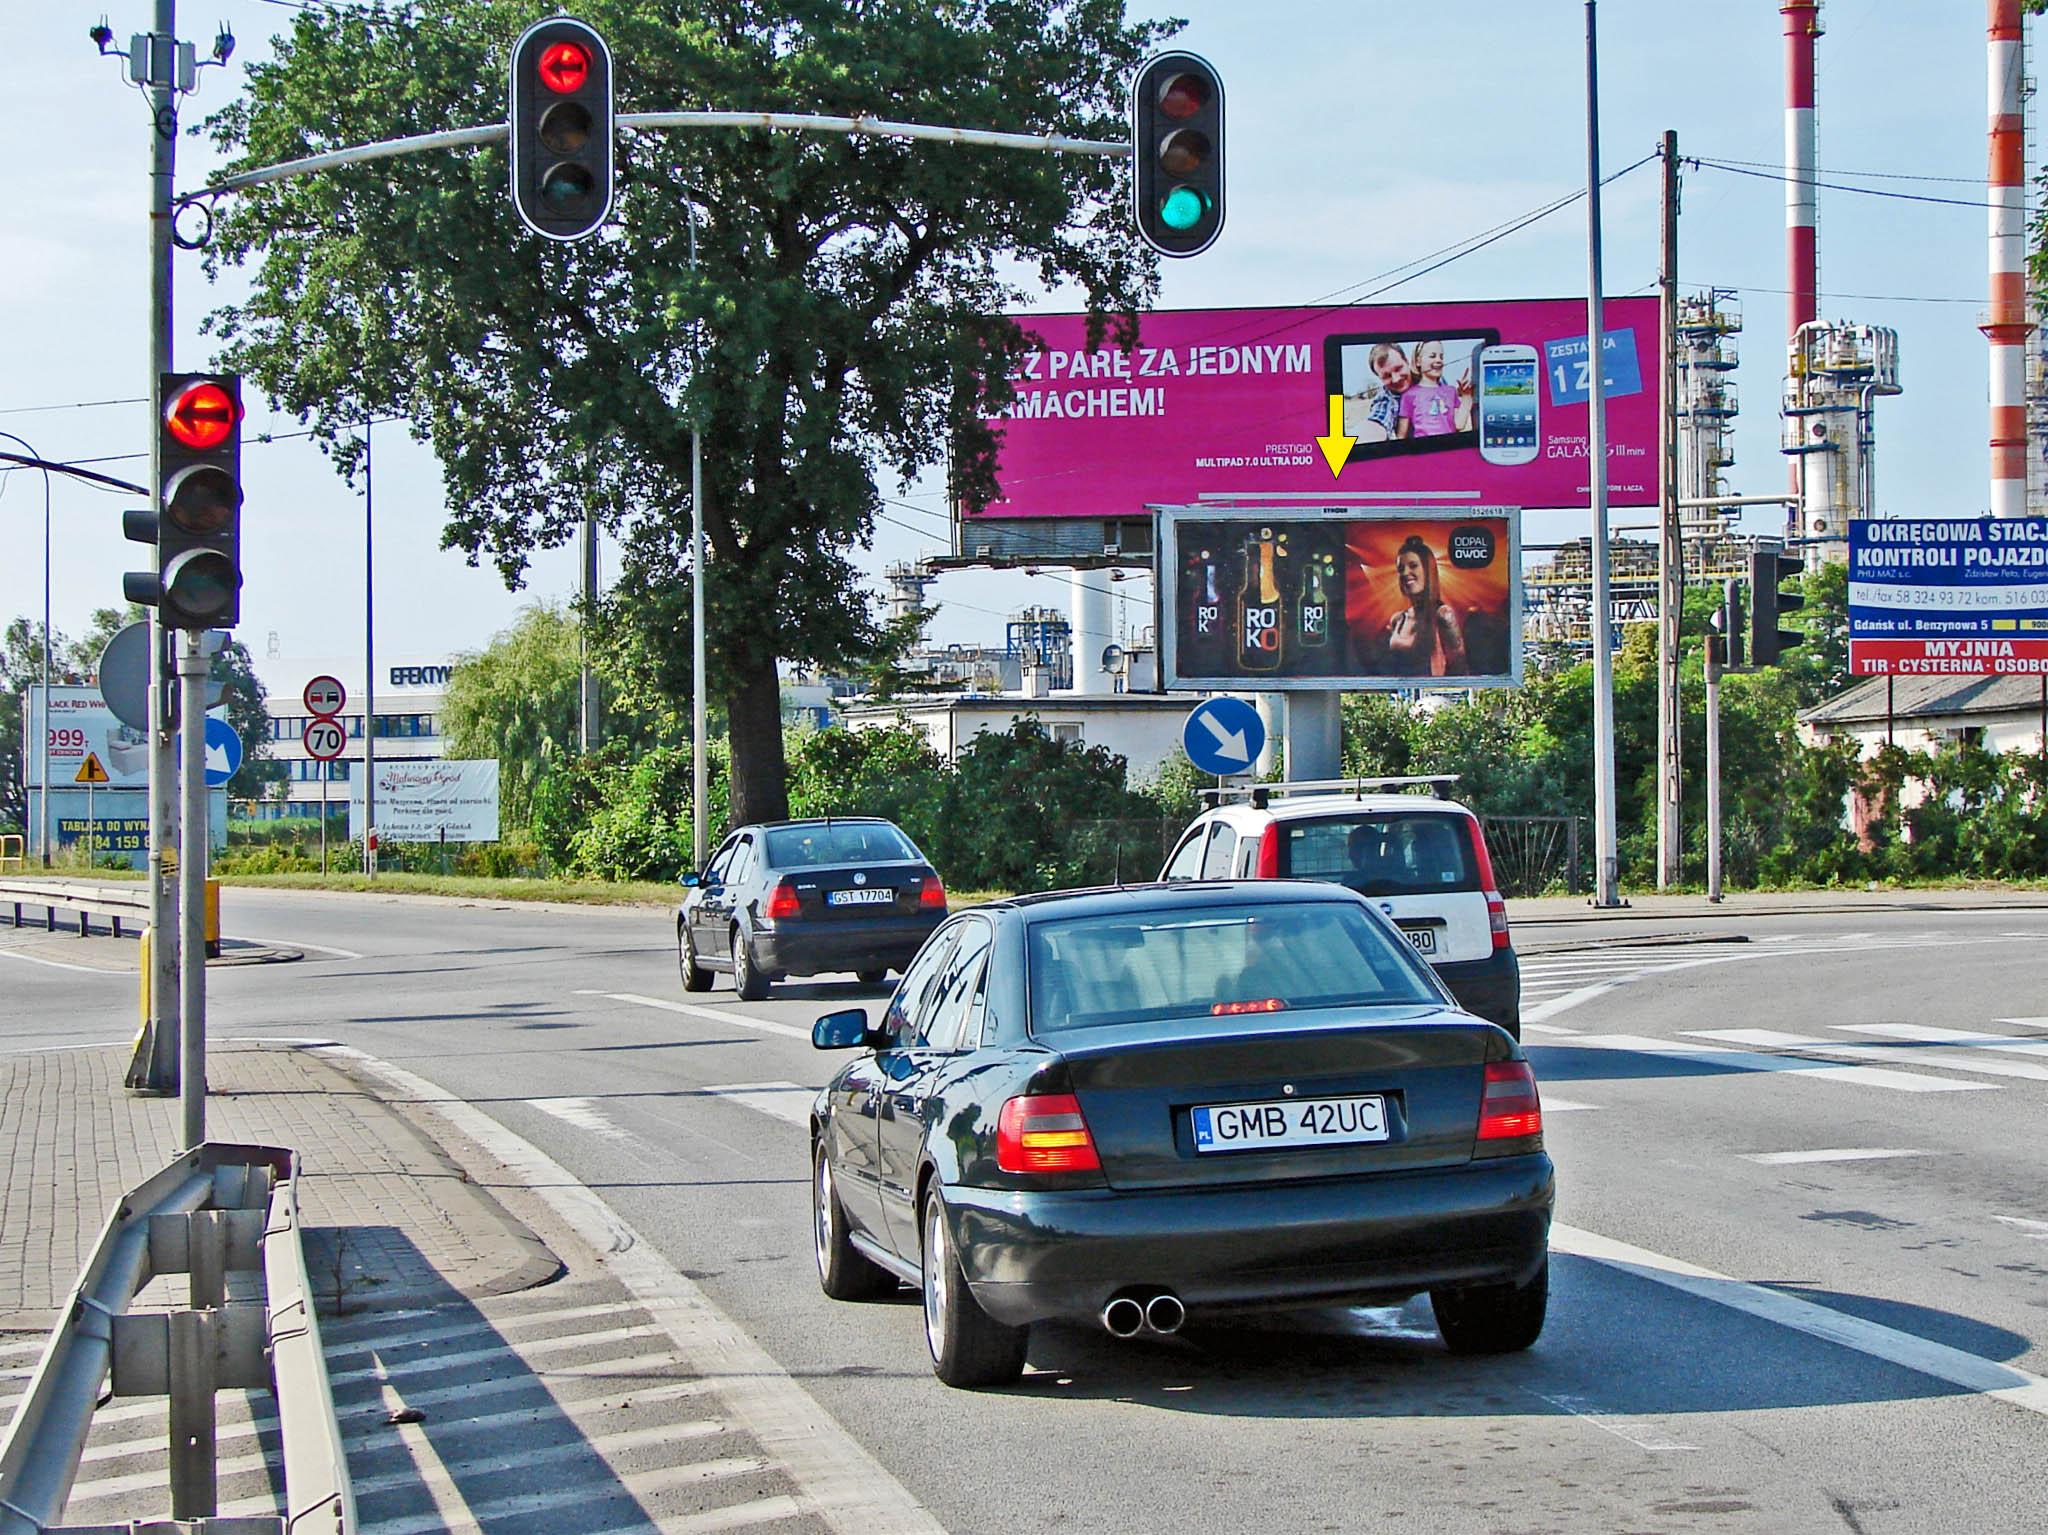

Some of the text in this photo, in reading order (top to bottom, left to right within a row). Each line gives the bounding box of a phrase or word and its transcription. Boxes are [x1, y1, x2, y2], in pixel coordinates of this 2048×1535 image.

[1550, 341, 1589, 358] ZESTA
[1050, 350, 1132, 383] PARĘ
[1139, 348, 1180, 377] ZA
[1185, 344, 1312, 376] JEDNYM
[1554, 364, 1567, 393] 1
[976, 387, 1166, 420] MACHEM!
[1548, 435, 1587, 445] Samsung
[1265, 443, 1313, 454] PRESTIGIO
[1547, 445, 1590, 459] GALAX
[1627, 447, 1645, 456] mini
[1195, 456, 1313, 468] MULTIPAD 7.0 ULTRA DUO
[1867, 522, 1982, 546] OKRĘGOWA
[1455, 536, 1488, 547] ODPAL
[1455, 549, 1488, 559] OWOC
[1857, 547, 2048, 567] KONTROLI POJAZD
[1896, 589, 1910, 603] 58
[1914, 590, 1935, 604] 324
[1939, 591, 1953, 605] 93
[1958, 591, 1972, 605] 72
[2005, 591, 2028, 605] 516
[1198, 607, 1218, 620] RO
[1246, 608, 1276, 628] RO
[1304, 606, 1323, 620] RO
[1854, 619, 1895, 631] Gdańsk
[1897, 619, 1912, 631] ul.
[1915, 619, 1978, 632] Benzynowa
[1981, 619, 1988, 630] 5
[1246, 628, 1279, 651] KO
[1924, 641, 2014, 657] MYJNIA
[1861, 658, 2048, 673] TIR CYSTERNA OSOBO
[48, 700, 69, 708] LACK
[71, 700, 88, 709] RED
[312, 729, 340, 750] 70
[61, 820, 103, 832] TABLICA
[106, 820, 119, 832] DO
[116, 835, 140, 849] 159
[834, 890, 892, 904] GST 17704
[1407, 931, 1431, 949] 80
[1216, 1102, 1378, 1140] GMB 42UC
[1199, 1131, 1211, 1141] PL
